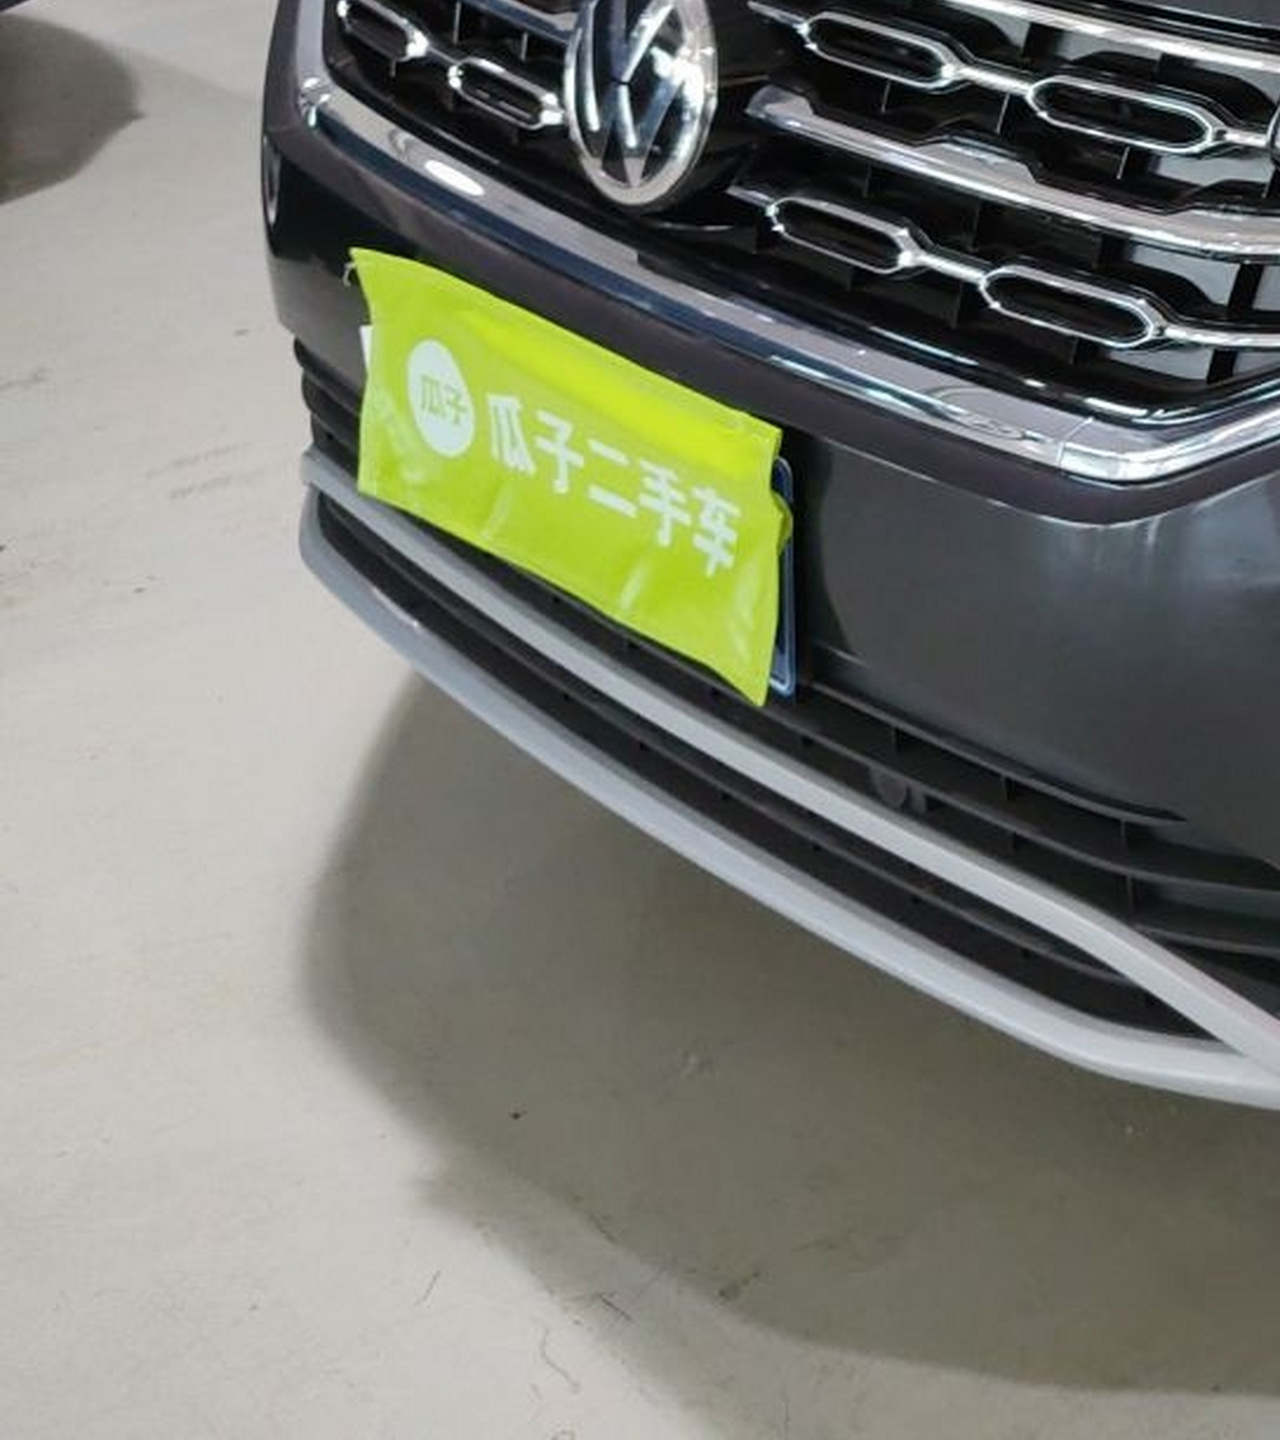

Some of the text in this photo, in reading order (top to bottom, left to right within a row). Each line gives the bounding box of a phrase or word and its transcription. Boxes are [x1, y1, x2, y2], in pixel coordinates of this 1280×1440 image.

[486, 391, 742, 579] 瓜子二手车
